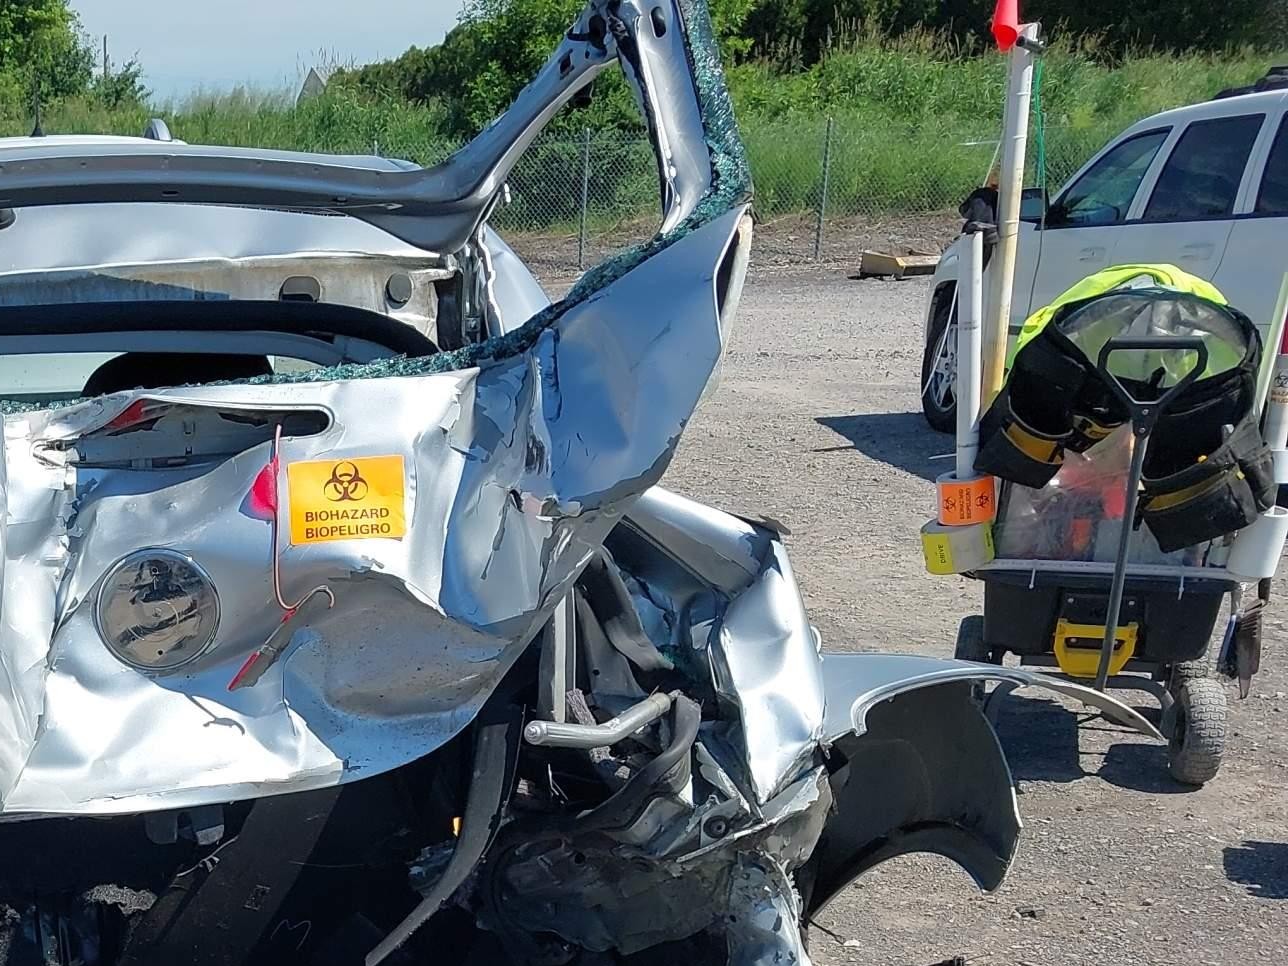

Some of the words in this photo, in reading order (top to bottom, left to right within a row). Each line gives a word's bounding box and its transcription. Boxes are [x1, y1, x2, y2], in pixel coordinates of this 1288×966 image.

[305, 507, 390, 522] BIOHAZARD
[305, 523, 391, 539] BIOPELIGRO
[938, 544, 946, 564] DRIVE
